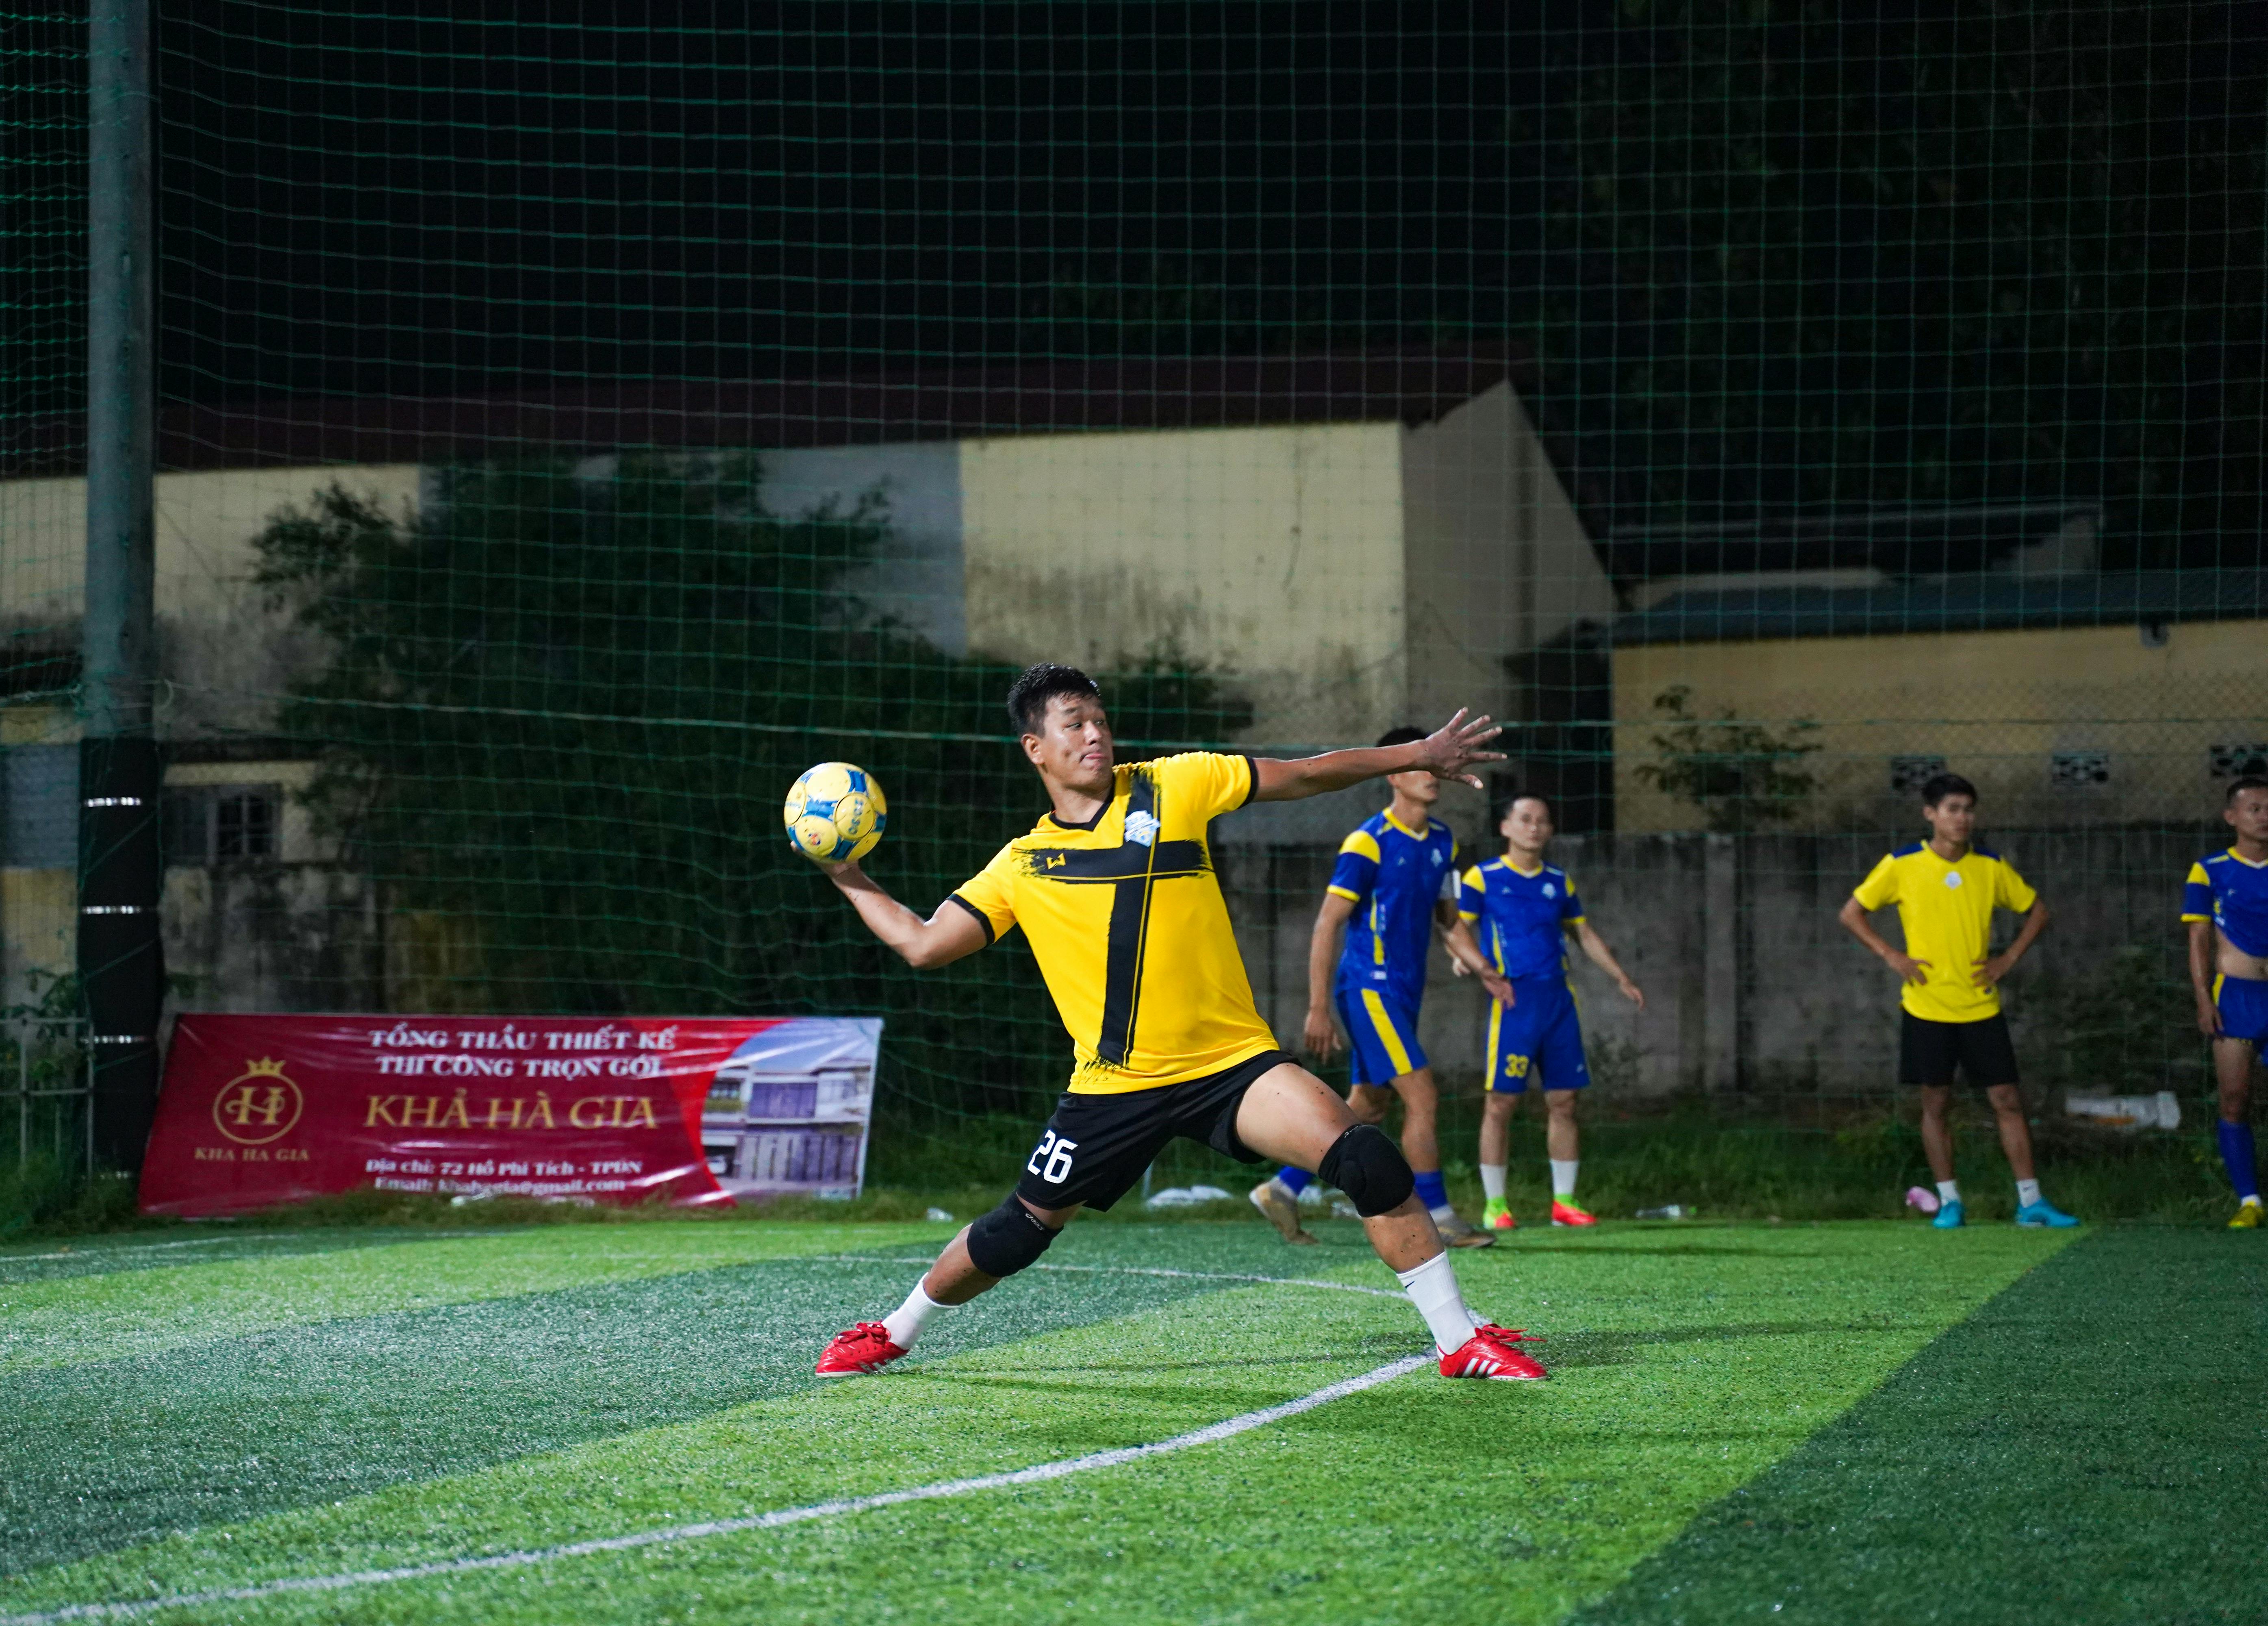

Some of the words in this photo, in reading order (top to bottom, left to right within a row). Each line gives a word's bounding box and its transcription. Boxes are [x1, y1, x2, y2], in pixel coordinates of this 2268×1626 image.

[543, 1024, 632, 1050] THIẾT
[638, 1024, 678, 1050] KẾ
[484, 1090, 556, 1129] HÀ
[569, 1096, 658, 1130] GIA
[274, 1148, 310, 1162] GIA
[1027, 1129, 1078, 1184] 26
[440, 1162, 464, 1176] 72
